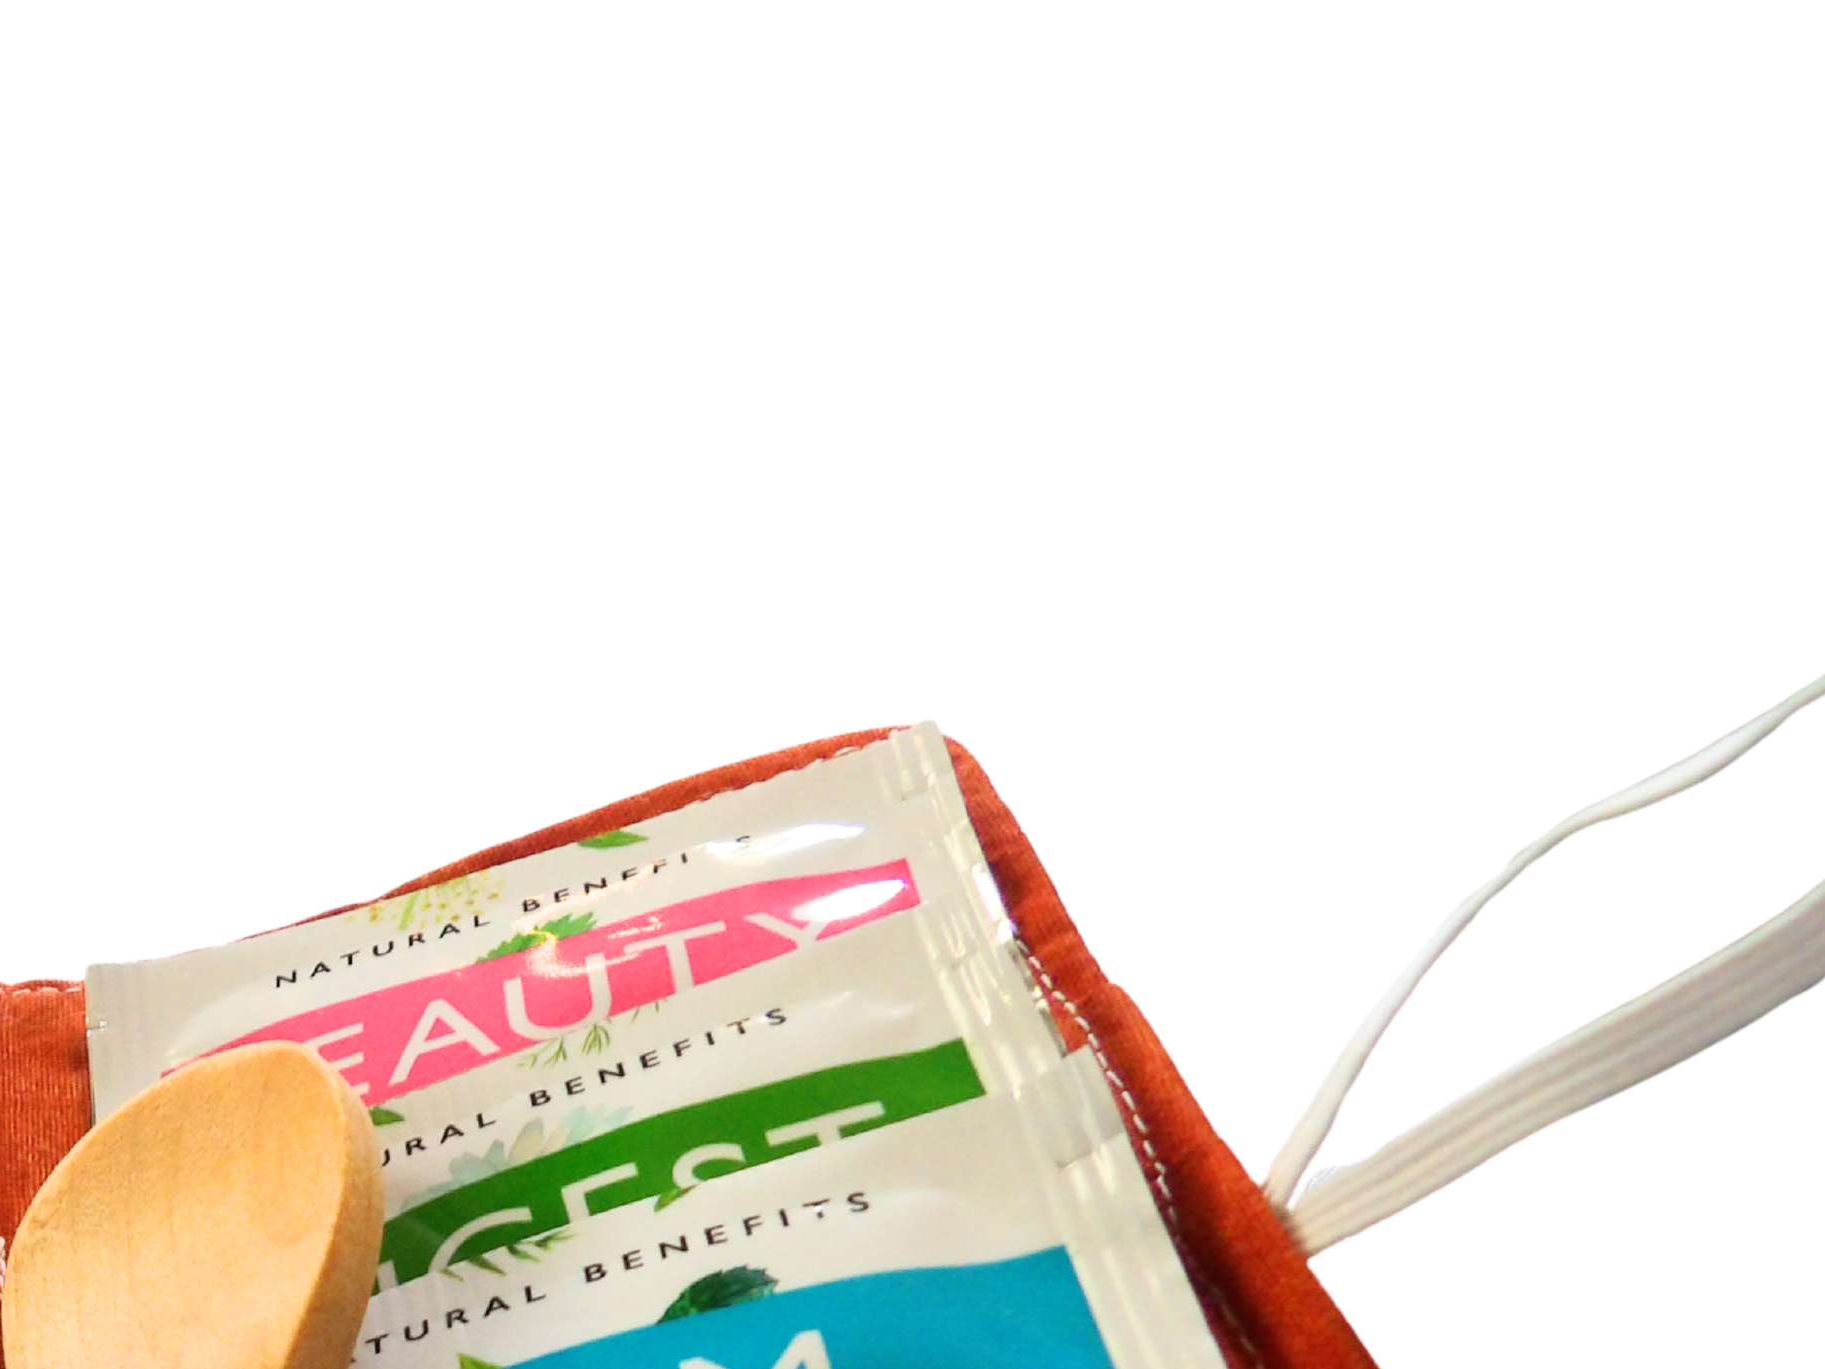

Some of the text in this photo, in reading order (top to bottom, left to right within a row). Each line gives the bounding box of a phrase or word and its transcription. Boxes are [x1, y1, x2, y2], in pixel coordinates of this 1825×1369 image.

[275, 835, 751, 988] NATURAL BENEFI
[529, 1007, 788, 1108] BENEFITS
[584, 1192, 871, 1284] BENEFITS
